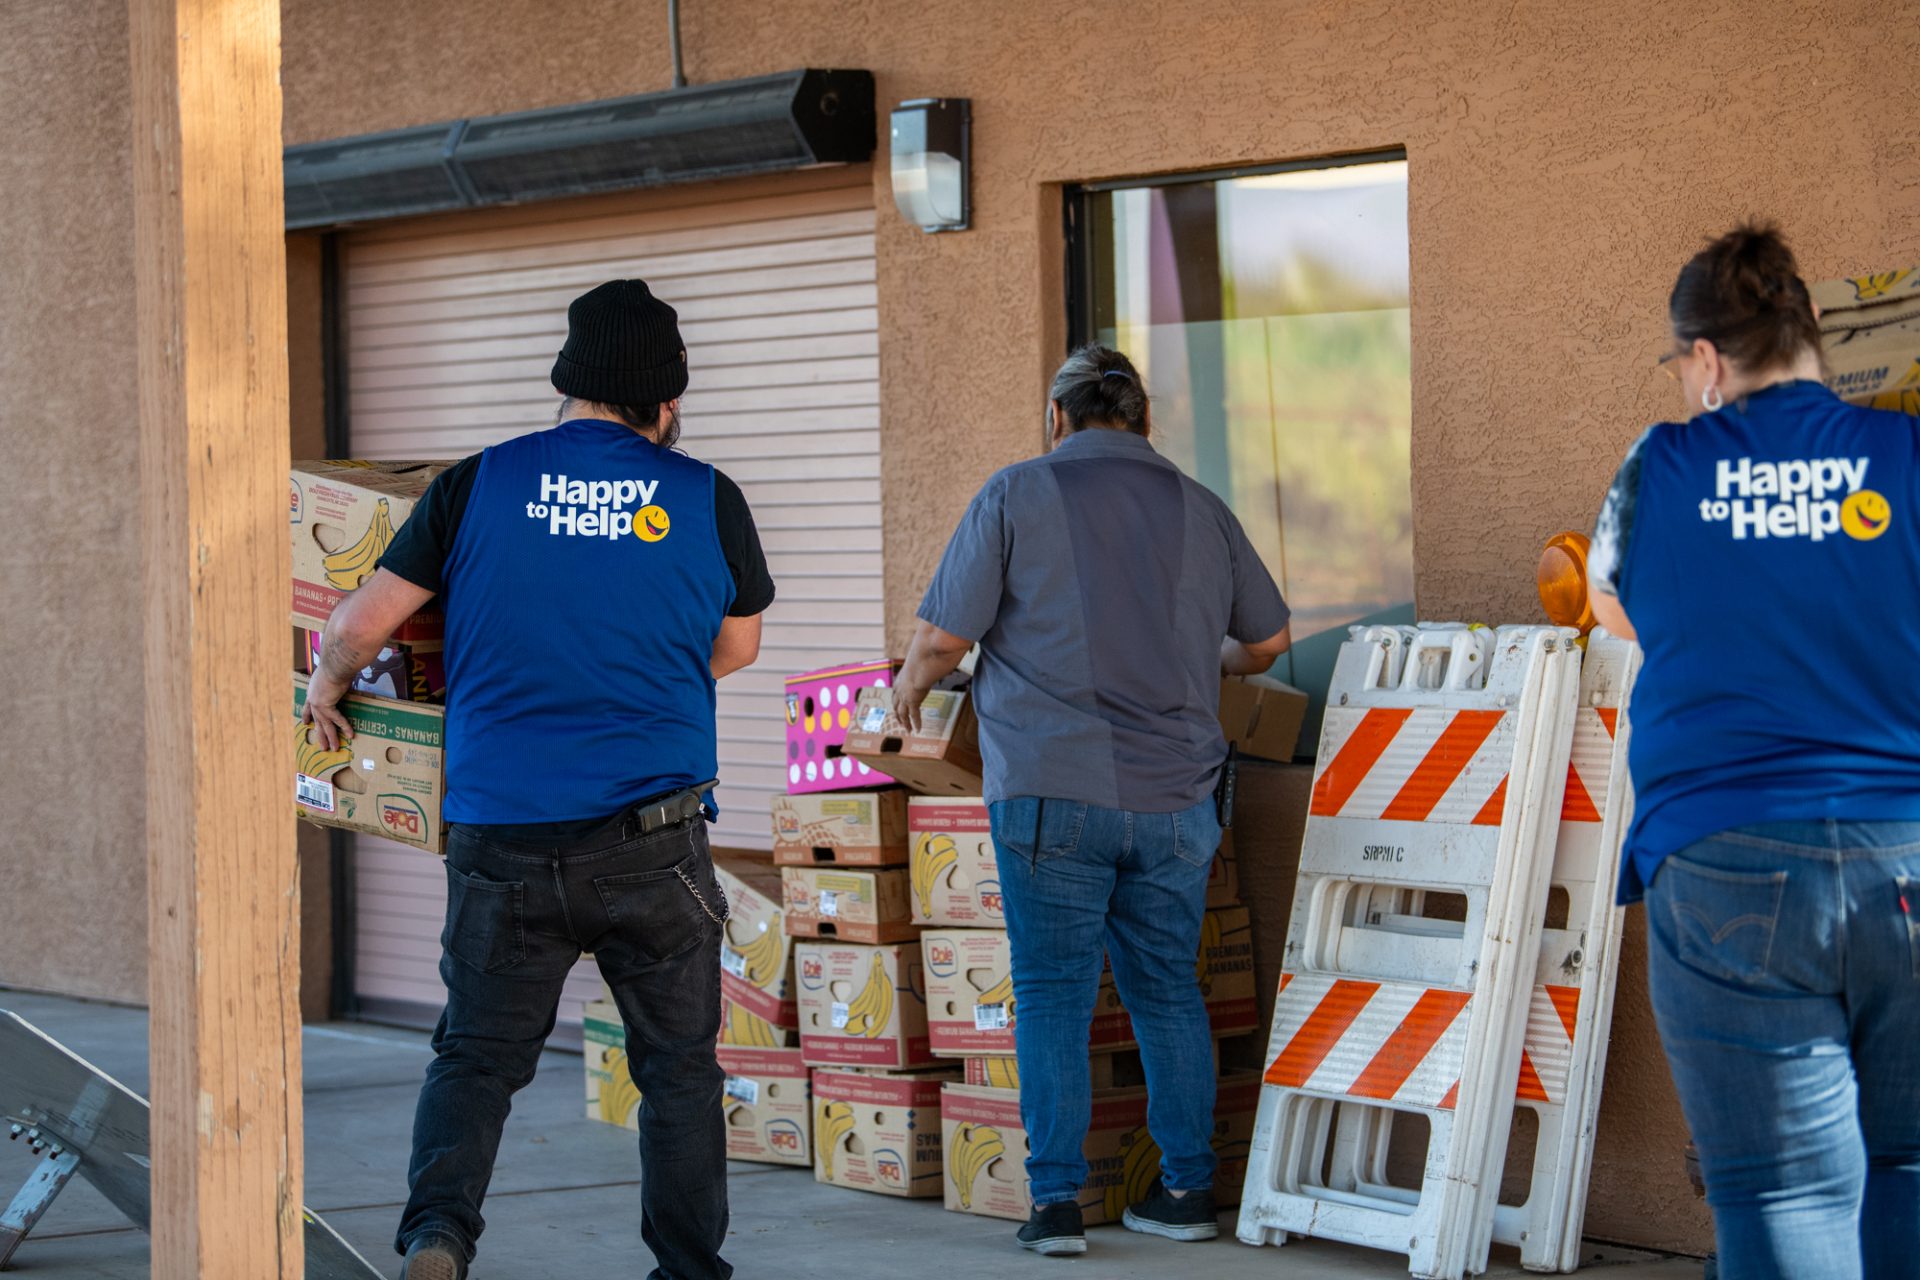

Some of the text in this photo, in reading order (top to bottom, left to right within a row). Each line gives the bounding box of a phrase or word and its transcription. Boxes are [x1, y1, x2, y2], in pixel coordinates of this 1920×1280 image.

[1716, 457, 1868, 500] Happy
[541, 474, 659, 511] Happy
[525, 501, 633, 541] to Help
[1699, 497, 1840, 541] to Help
[394, 726, 440, 745] BANANAS
[383, 809, 419, 834] Dole
[931, 946, 954, 963] Dole
[1205, 942, 1251, 959] PREMIUM
[1206, 957, 1252, 975] BANANAS
